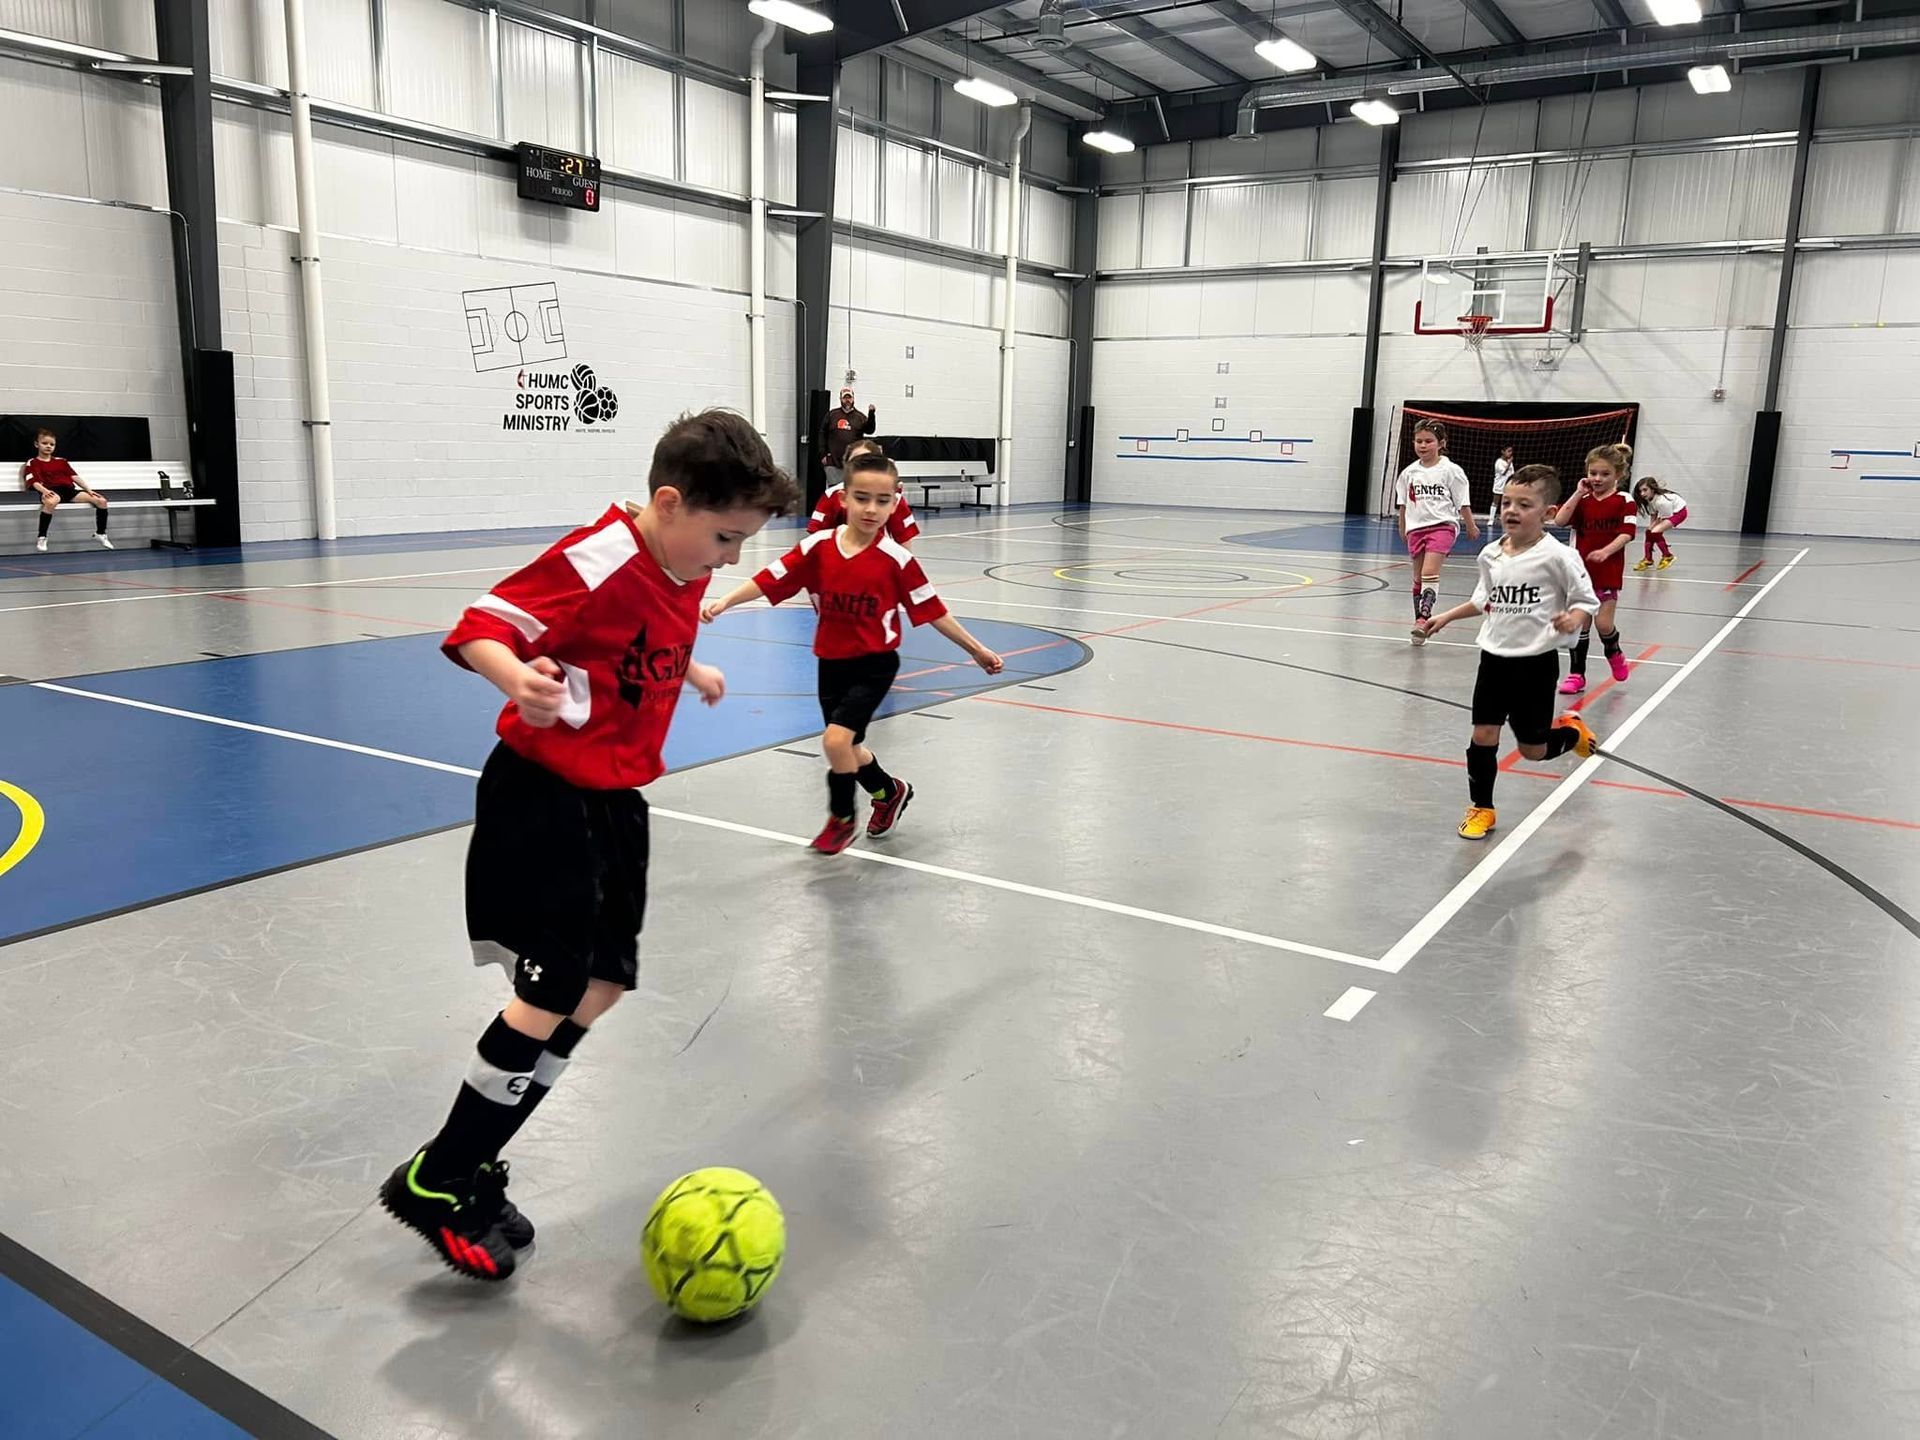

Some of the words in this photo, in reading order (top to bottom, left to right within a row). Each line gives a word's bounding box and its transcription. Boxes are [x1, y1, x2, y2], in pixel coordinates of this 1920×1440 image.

[526, 166, 552, 181] HOME
[551, 186, 573, 197] PERIOD
[572, 176, 598, 190] GUEST
[585, 189, 595, 206] 0
[528, 373, 569, 390] HUMC
[516, 393, 570, 411] SPORTS
[503, 414, 570, 431] MINISTRY
